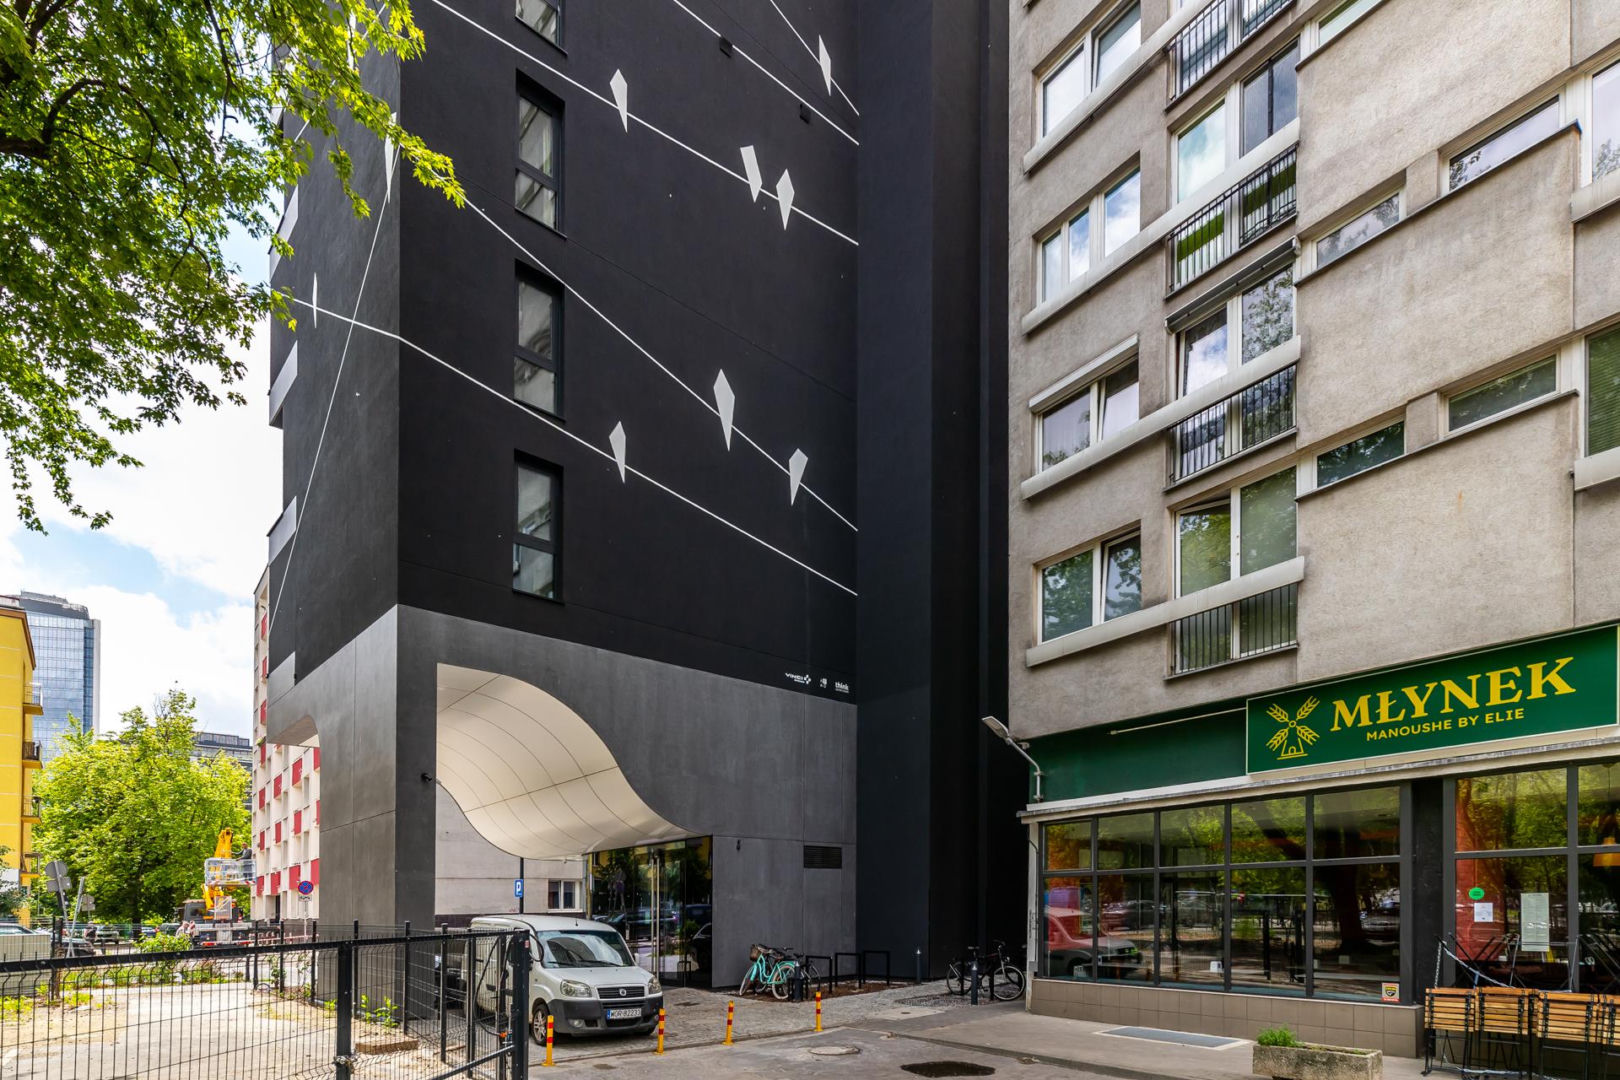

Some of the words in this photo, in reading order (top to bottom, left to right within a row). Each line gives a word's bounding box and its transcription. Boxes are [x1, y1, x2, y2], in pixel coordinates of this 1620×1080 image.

[1330, 657, 1577, 731] MŁYNEK
[1367, 720, 1452, 741] MANOUSHE
[1458, 716, 1479, 729] BY
[1486, 708, 1524, 724] ELIE
